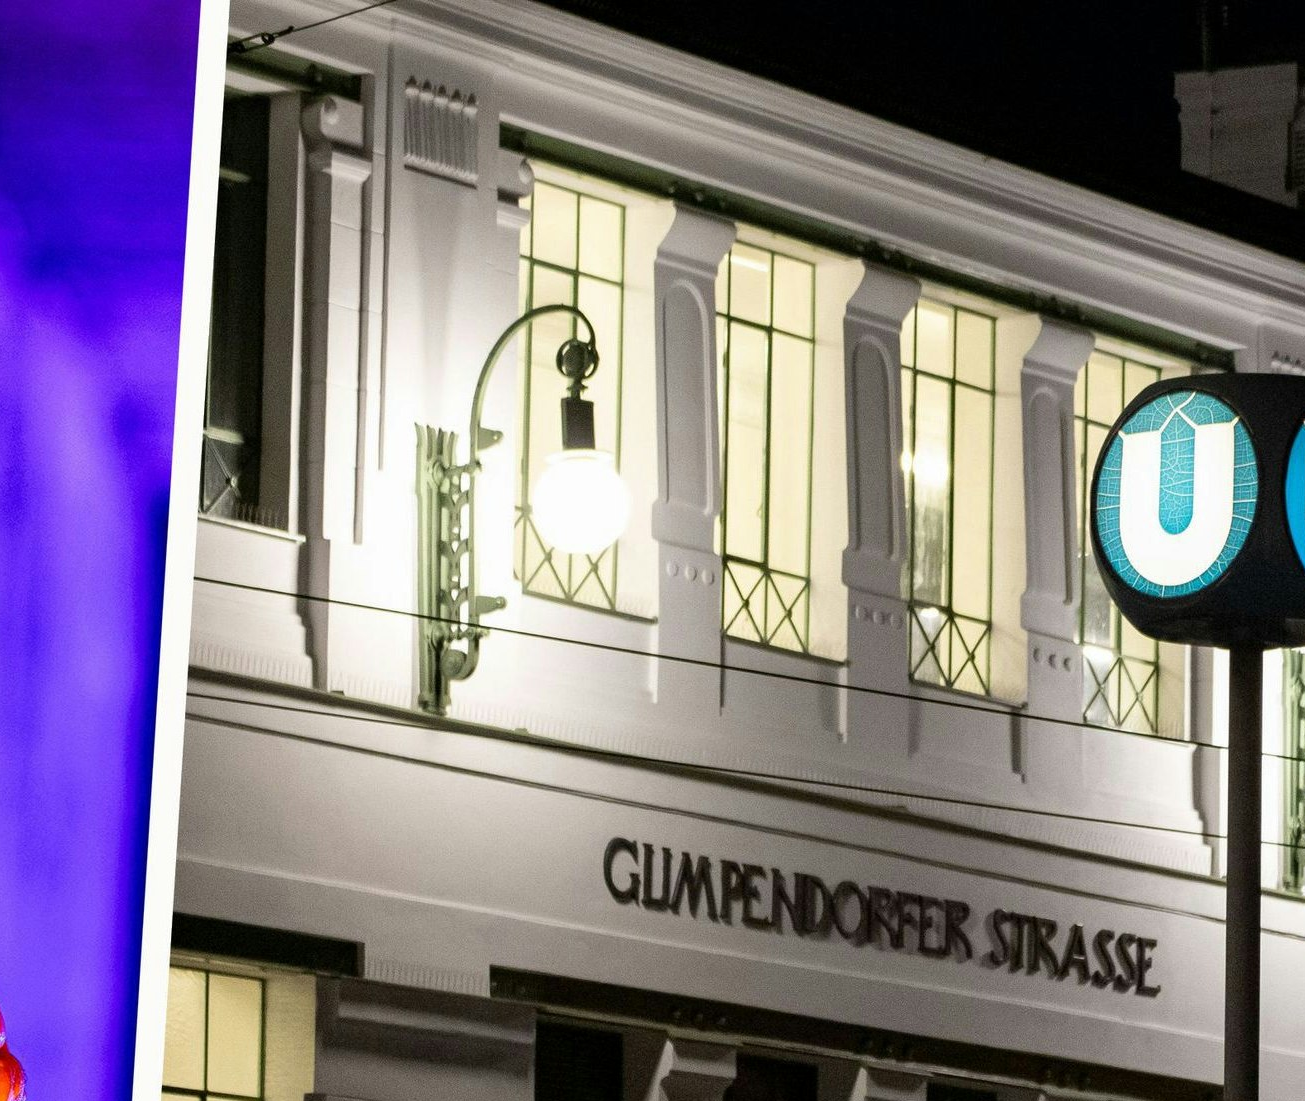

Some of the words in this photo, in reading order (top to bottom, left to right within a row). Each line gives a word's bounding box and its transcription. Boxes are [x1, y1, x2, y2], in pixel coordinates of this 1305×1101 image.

[1119, 415, 1235, 587] U
[603, 836, 973, 960] GUMPENDORFER
[986, 907, 1162, 997] STRASSE
